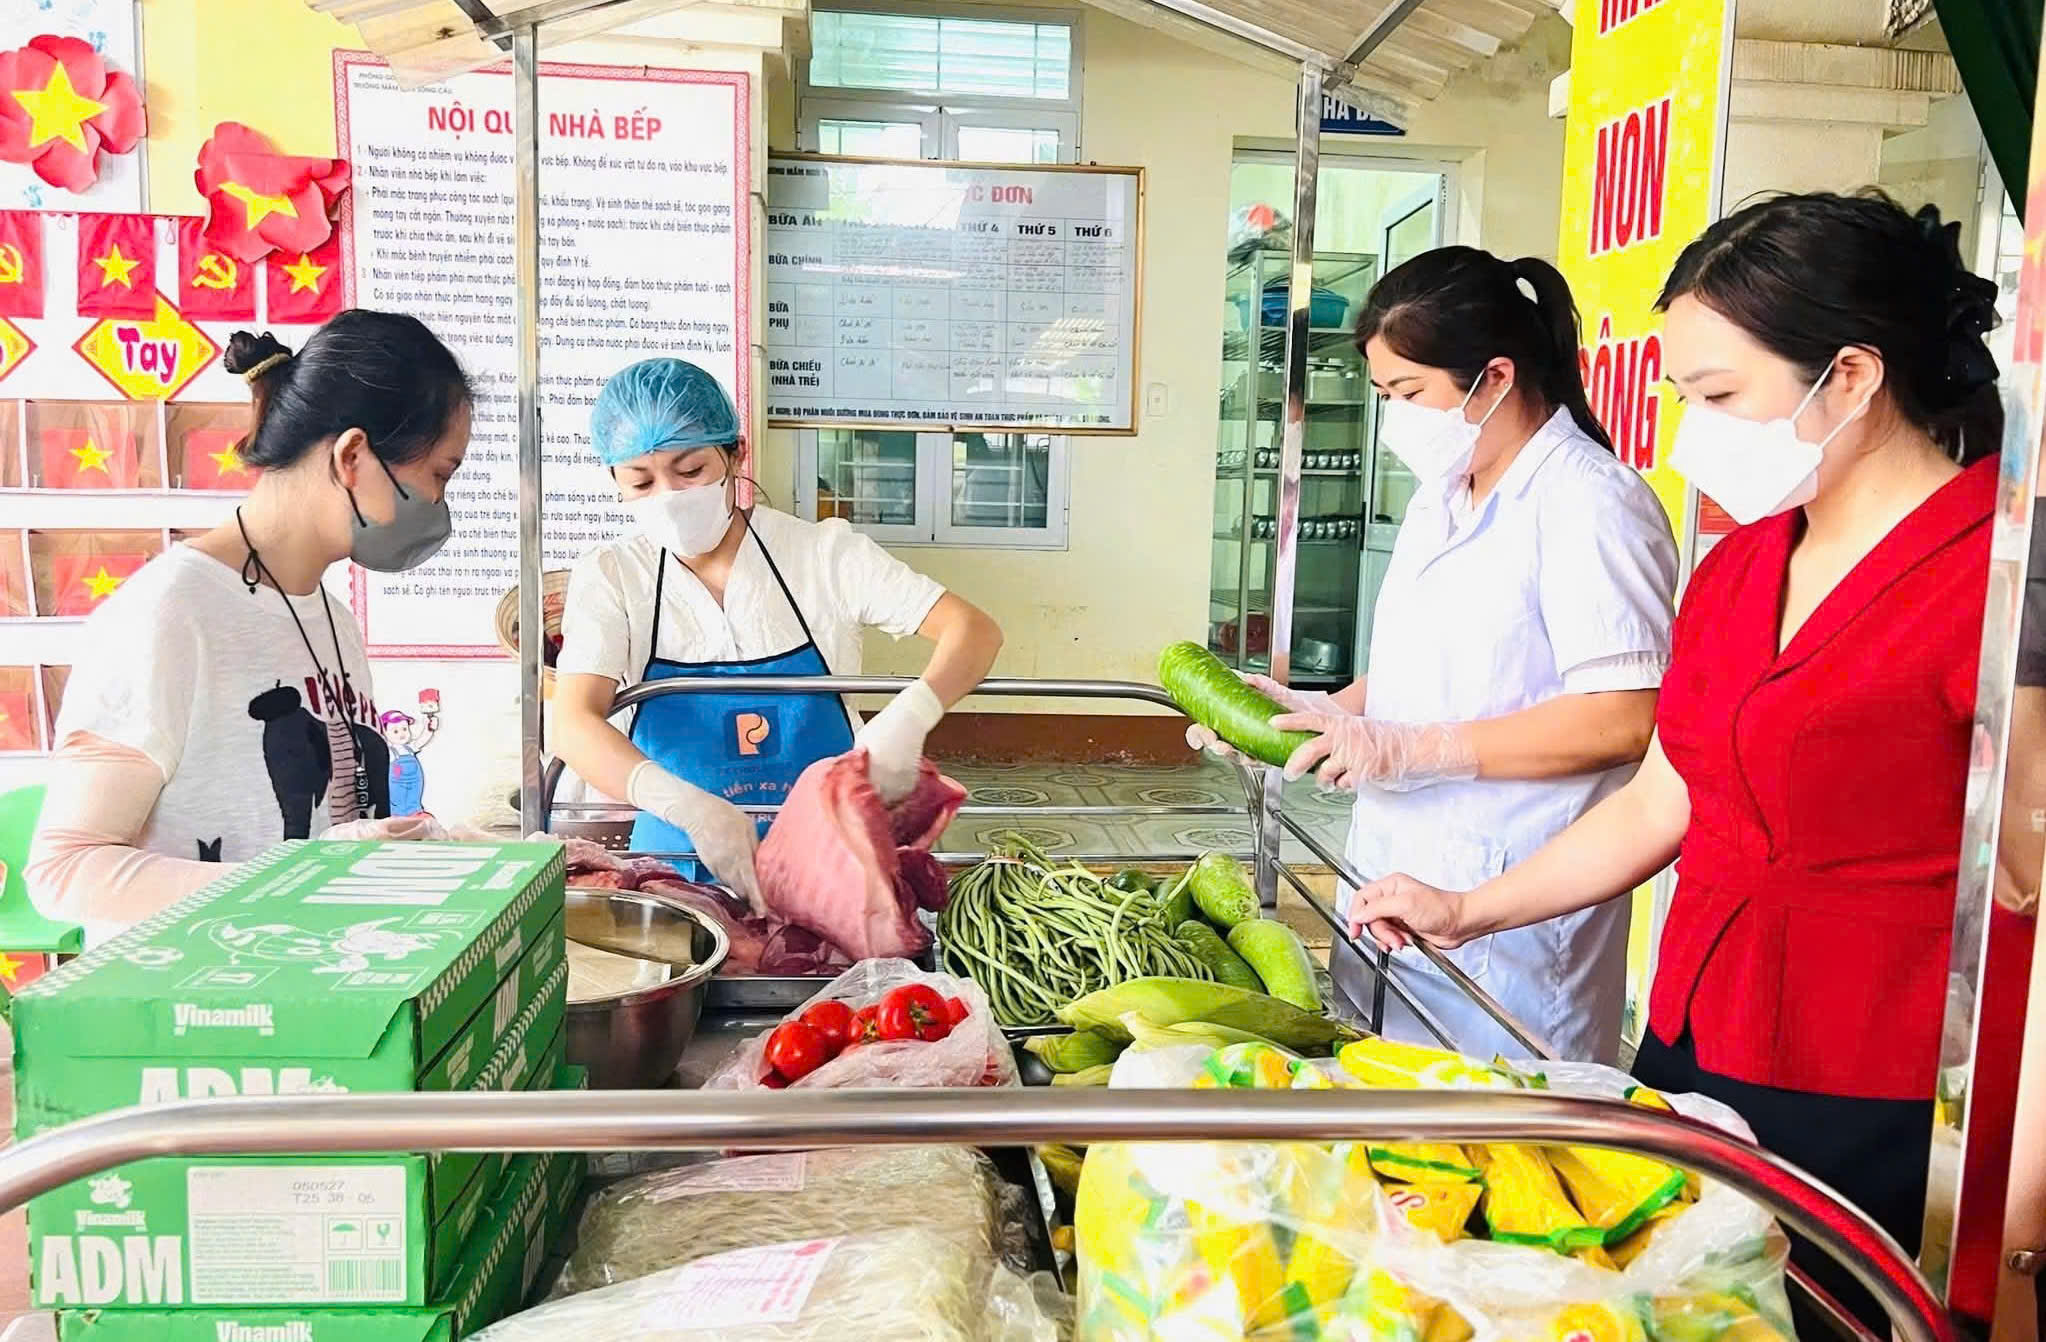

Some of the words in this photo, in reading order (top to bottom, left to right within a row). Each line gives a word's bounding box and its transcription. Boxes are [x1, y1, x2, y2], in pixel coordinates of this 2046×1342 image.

[428, 101, 475, 140] NỘI
[484, 109, 514, 135] QU
[549, 108, 605, 139] NHÀ
[613, 106, 662, 140] BẾP
[1590, 99, 1670, 255] NON
[991, 185, 1033, 204] ĐƠN
[768, 213, 798, 226] BỮA
[1018, 222, 1046, 235] THỨ
[1048, 226, 1056, 236] 5
[1075, 224, 1102, 237] THỨ
[768, 253, 789, 265] BỮA
[769, 301, 789, 313] BỮA
[769, 318, 789, 330] PHỤ
[117, 327, 177, 383] Tay
[769, 359, 789, 371] BỮA
[792, 358, 821, 371] CHIỀU
[771, 374, 795, 386] (NHÀ
[799, 373, 820, 387] TRẺ)
[1578, 317, 1661, 470] ÔNG
[173, 1003, 274, 1036] Vinamilk
[39, 1235, 183, 1304] ADM
[216, 1320, 312, 1342] Vinamilk
